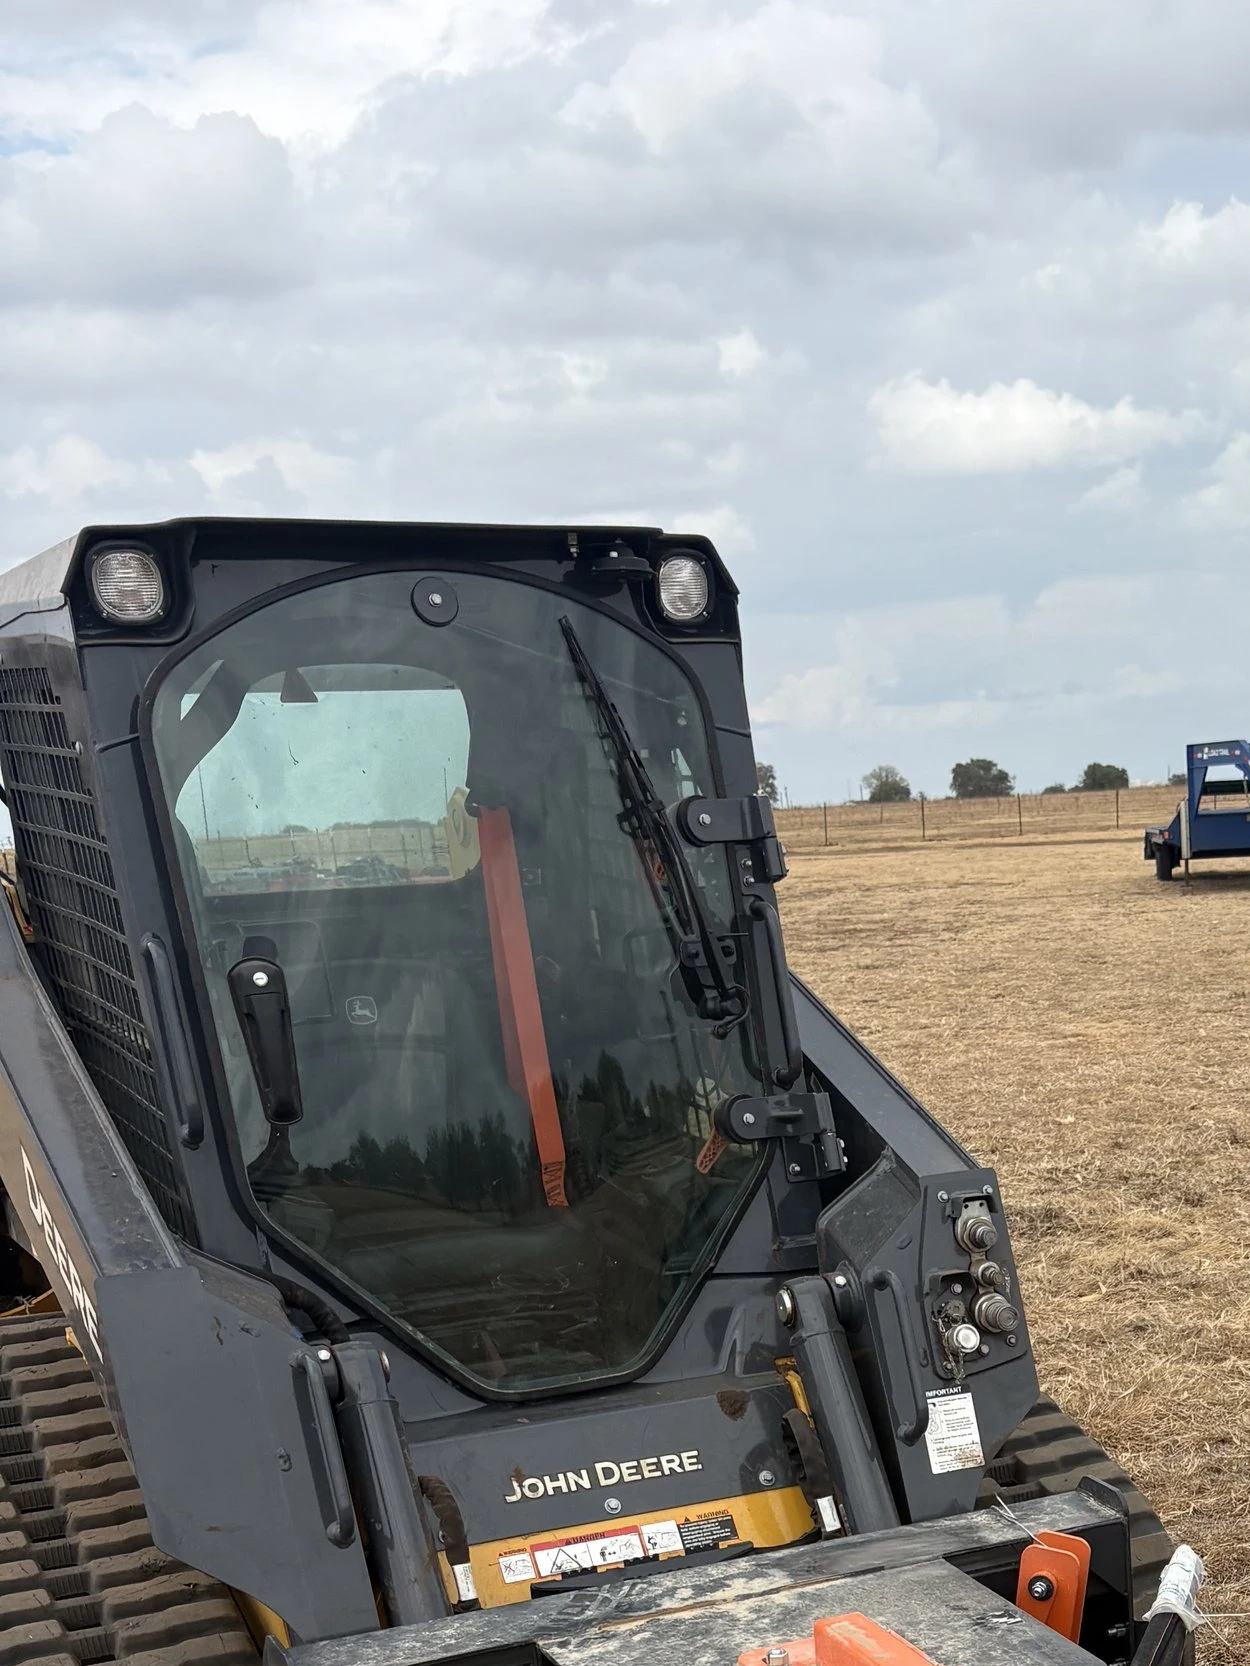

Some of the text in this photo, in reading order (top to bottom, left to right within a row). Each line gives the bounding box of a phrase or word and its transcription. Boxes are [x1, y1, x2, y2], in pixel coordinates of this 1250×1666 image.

[20, 1144, 105, 1365] DEERE
[925, 1386, 962, 1397] IMPORTANT
[504, 1450, 702, 1503] JOHN DEERE
